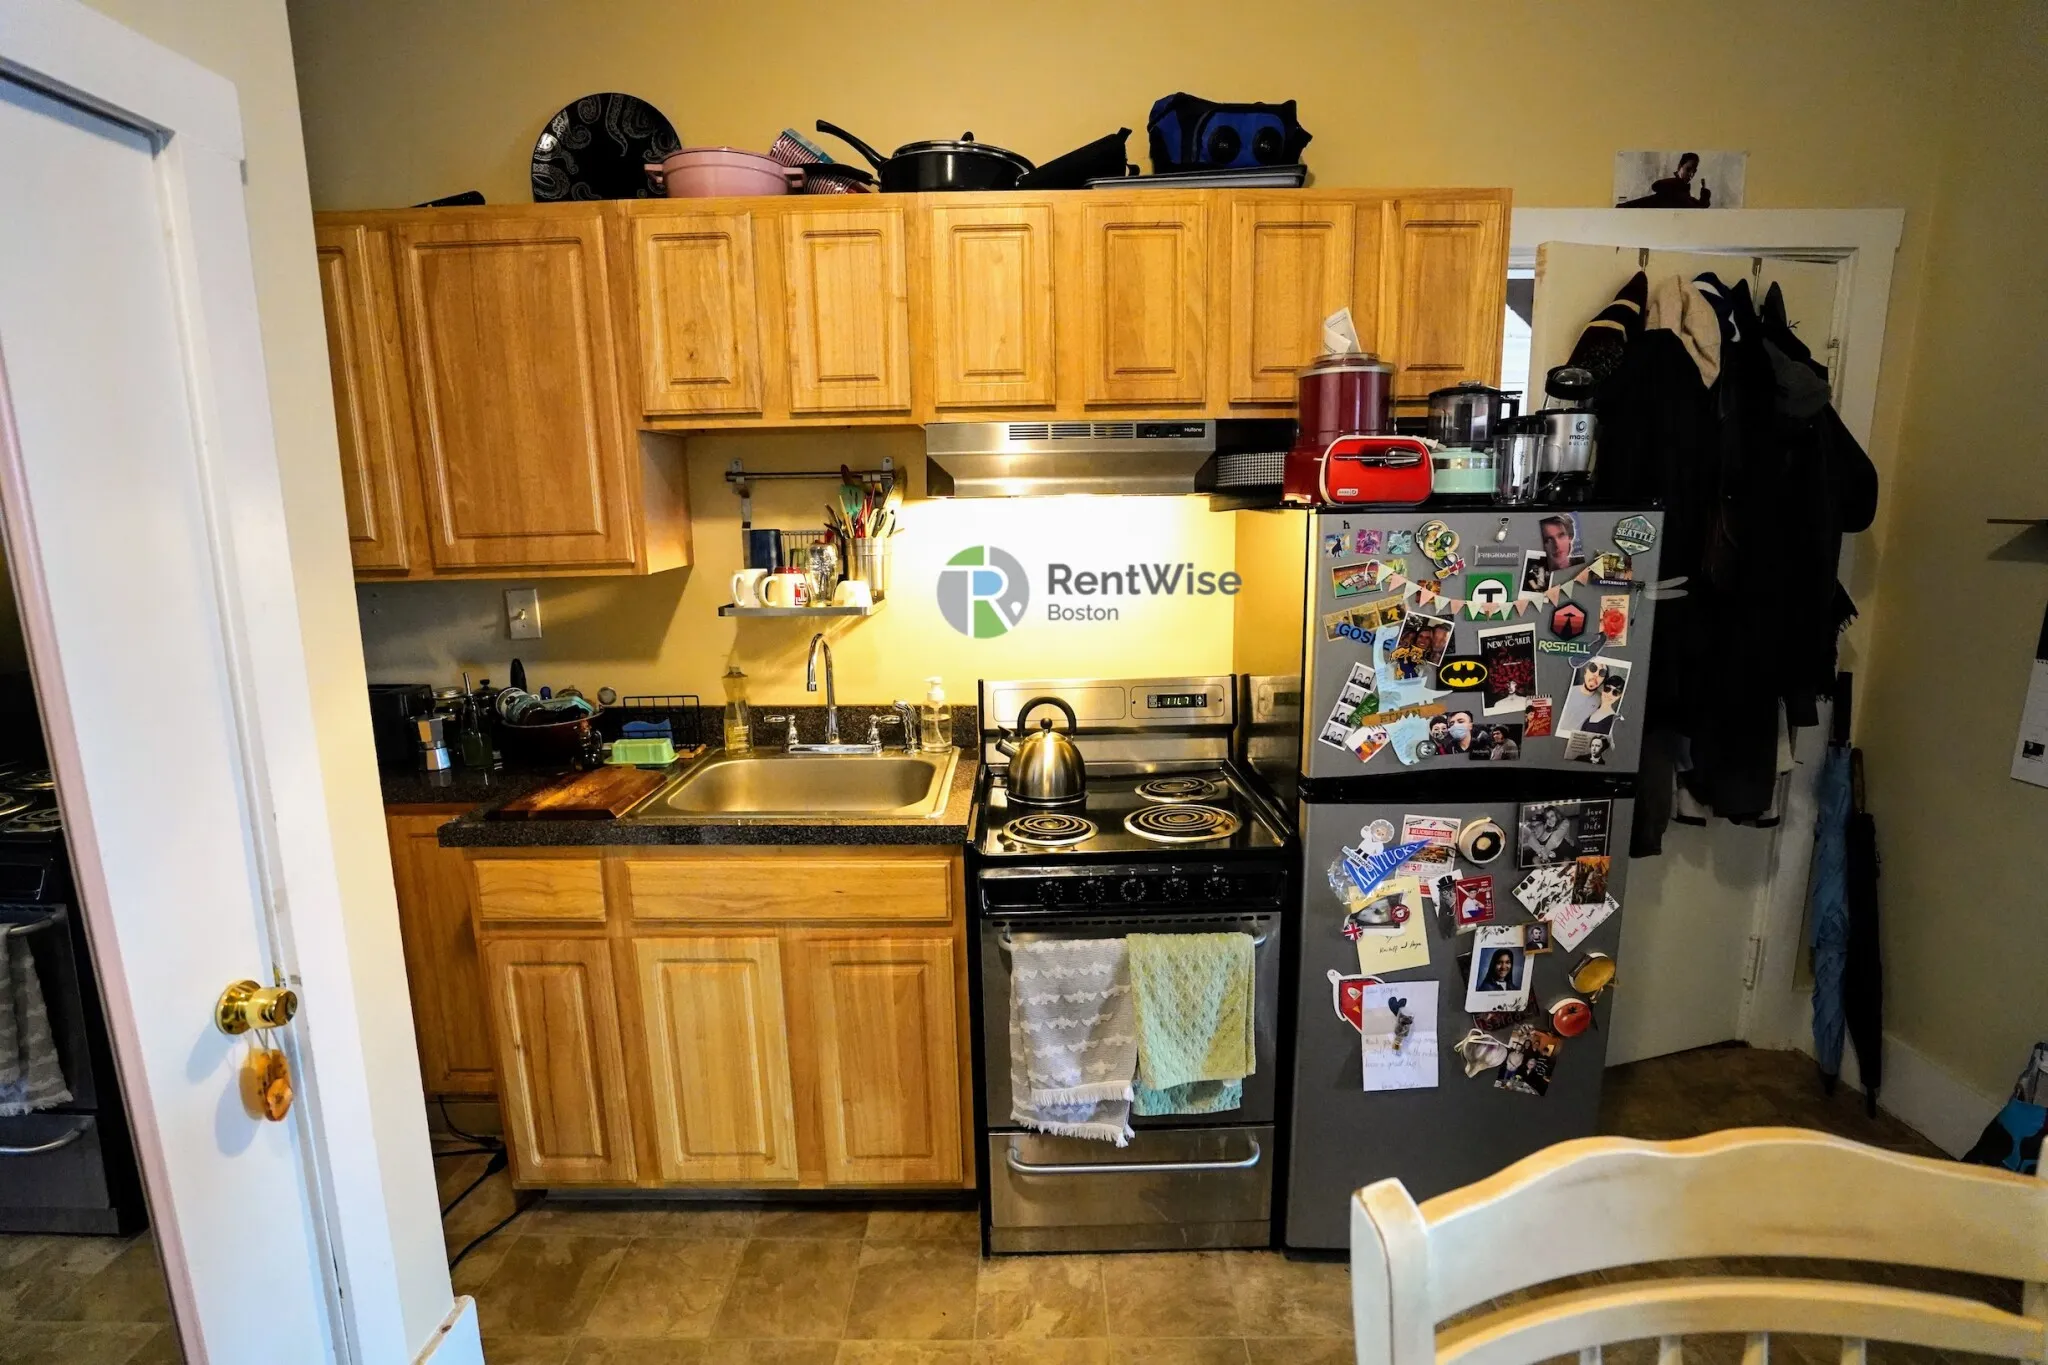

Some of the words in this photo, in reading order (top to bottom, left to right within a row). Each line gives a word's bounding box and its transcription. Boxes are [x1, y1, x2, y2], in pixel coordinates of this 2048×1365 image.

[1342, 520, 1351, 529] h
[1616, 527, 1656, 544] SEATTLE
[1478, 588, 1503, 603] T
[1487, 640, 1504, 649] NEW
[1356, 844, 1419, 889] KENTUCKY
